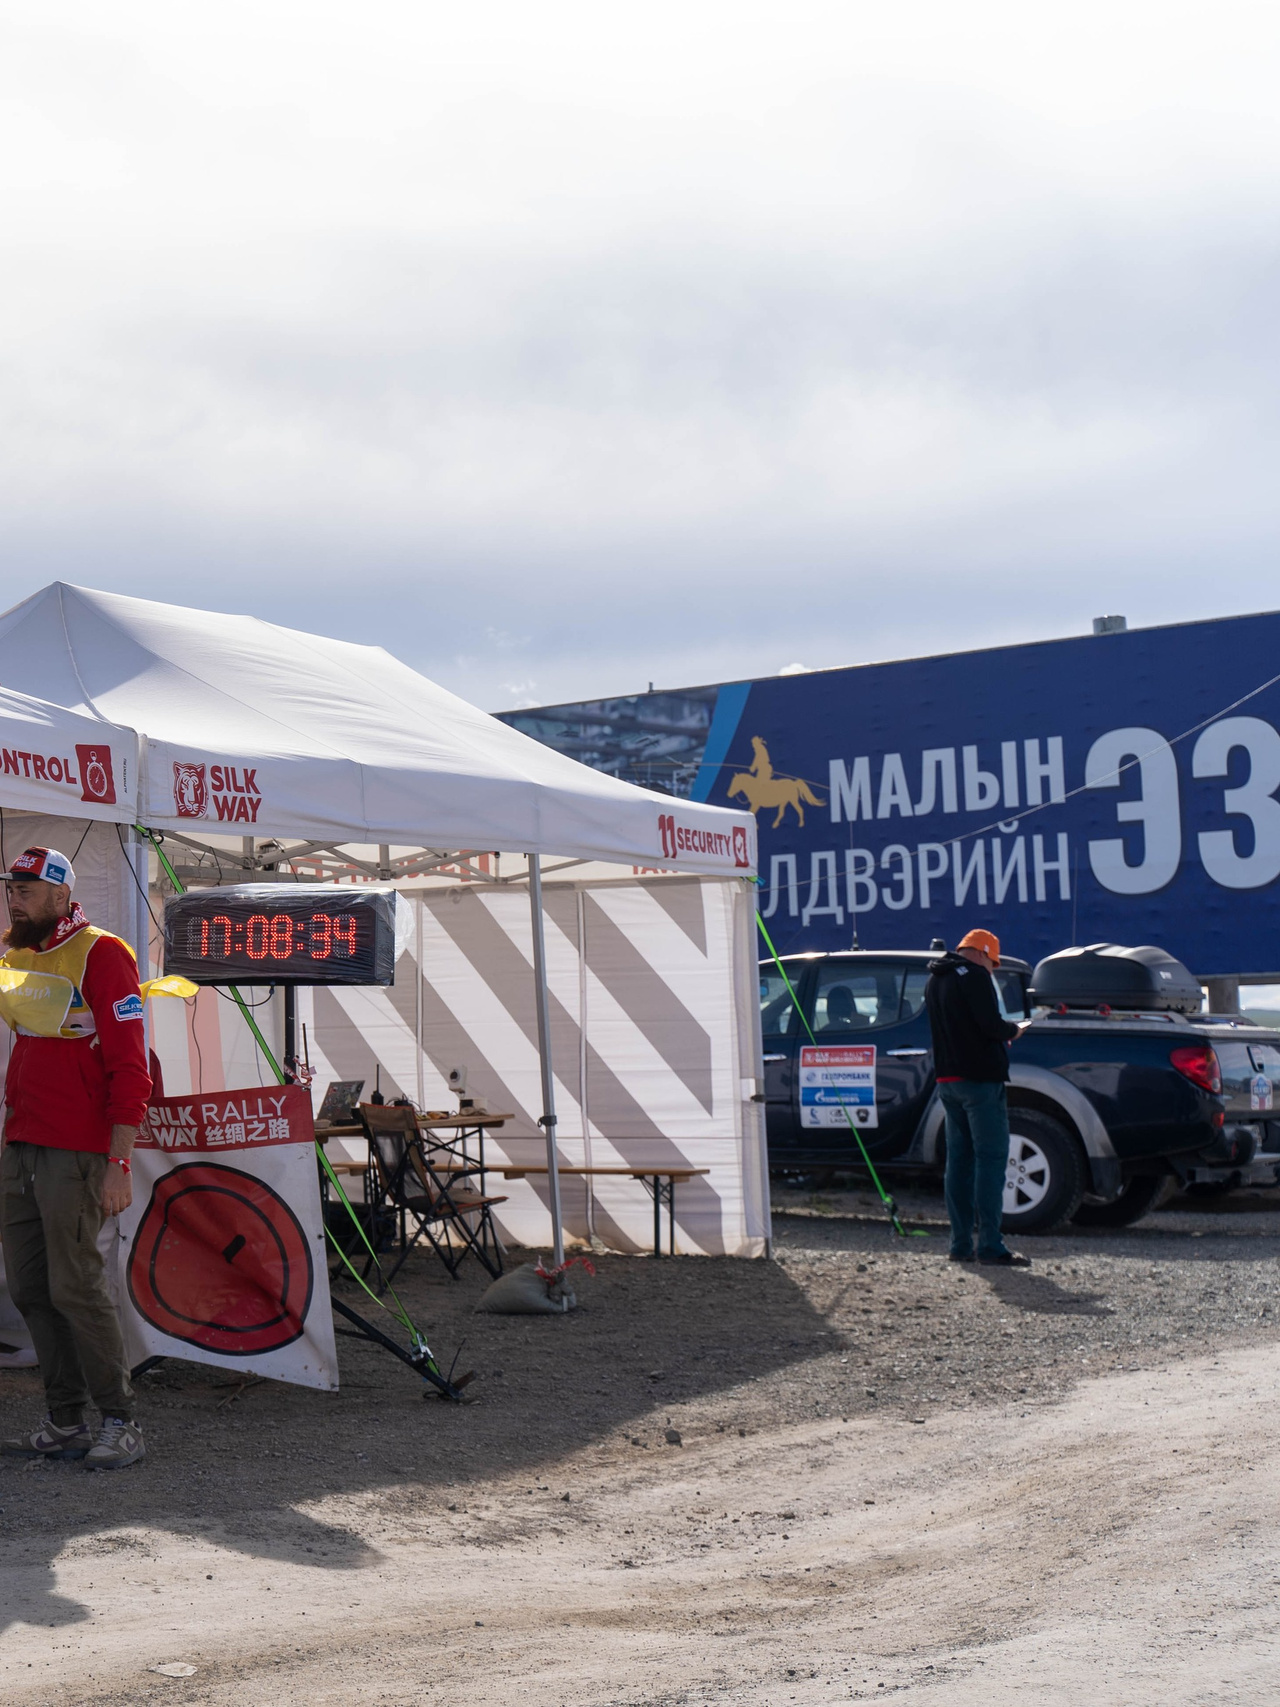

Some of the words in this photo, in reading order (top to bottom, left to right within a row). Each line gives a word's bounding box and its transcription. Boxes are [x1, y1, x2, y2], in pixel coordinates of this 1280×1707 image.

[211, 765, 260, 795] SILK
[828, 736, 1066, 824] МАЛЫН
[212, 795, 261, 823] WAY
[658, 814, 678, 859] 11
[677, 826, 731, 857] SECURITY
[19, 854, 38, 864] SILK
[201, 914, 356, 959] 17:08:34
[148, 1105, 197, 1126] SILK
[201, 1096, 287, 1124] RALLY
[152, 1126, 198, 1147] WAY
[205, 1118, 291, 1147] 丝绸之路
